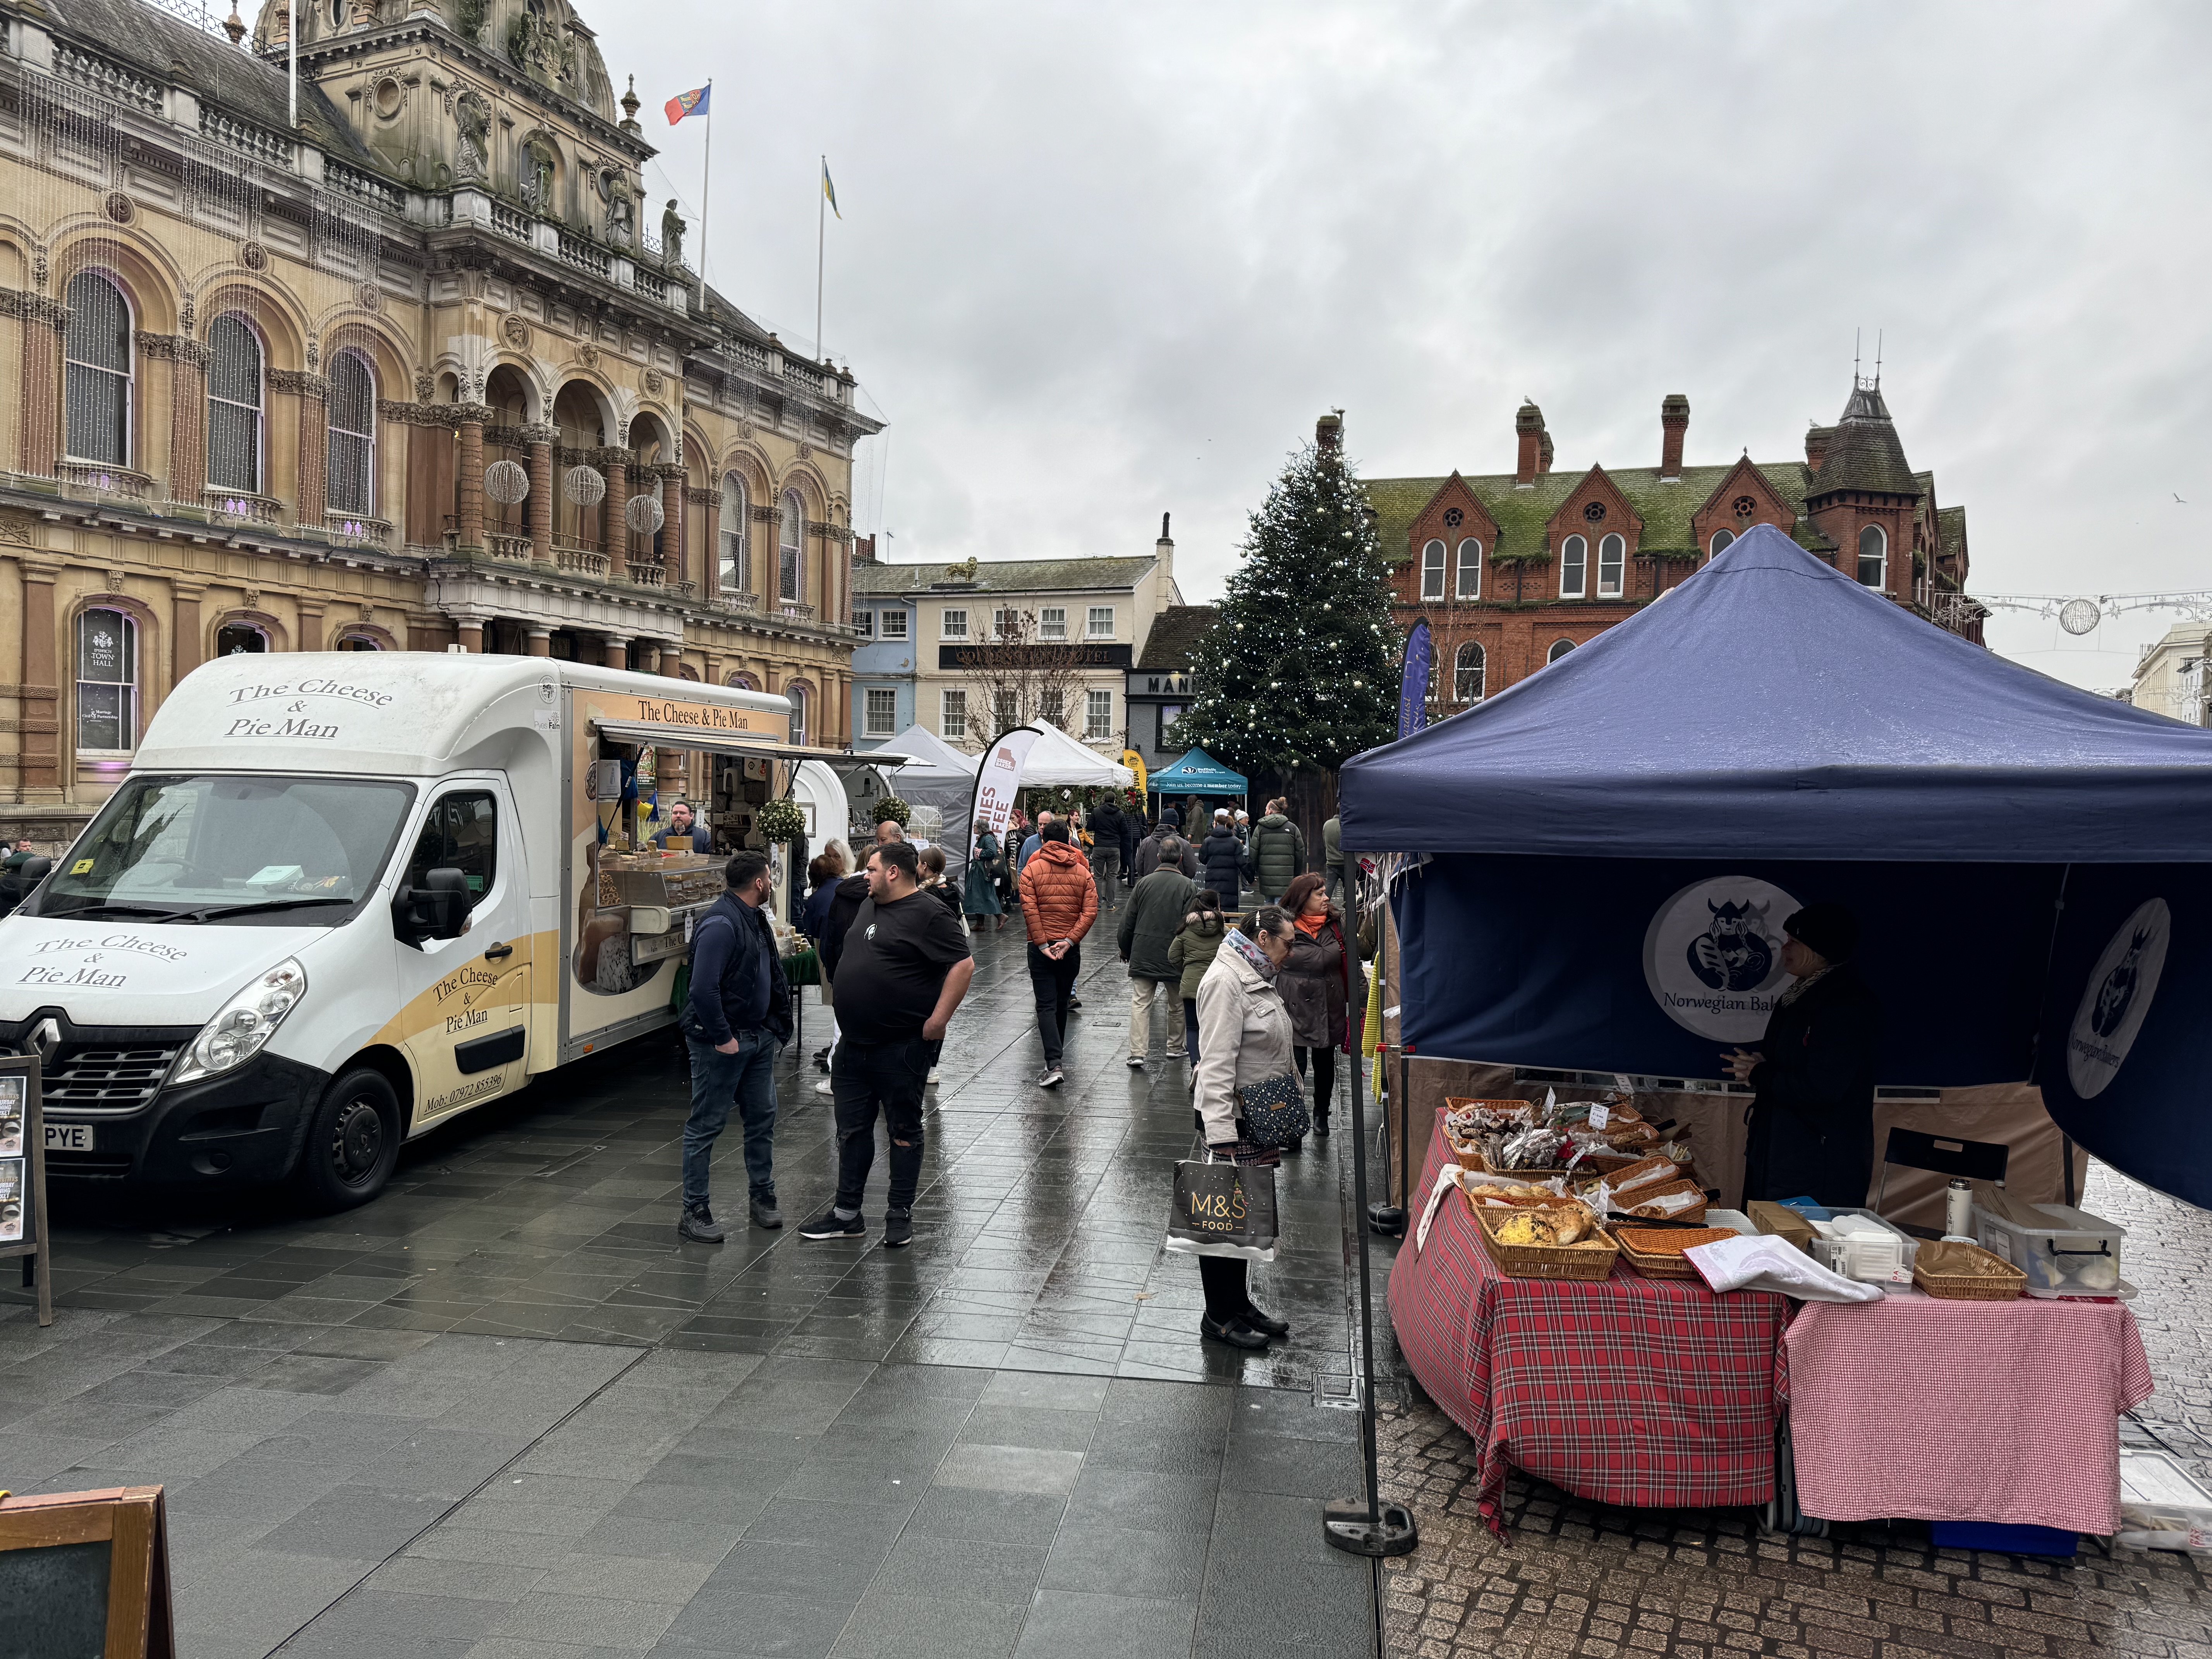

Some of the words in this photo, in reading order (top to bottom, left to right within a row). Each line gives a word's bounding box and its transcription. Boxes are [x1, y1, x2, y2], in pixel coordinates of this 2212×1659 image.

[1061, 651, 1112, 662] HOTEL
[229, 684, 289, 703] The
[298, 679, 393, 706] Cheese
[287, 700, 308, 713] &
[638, 699, 660, 721] The
[663, 703, 699, 725] Cheese
[702, 708, 710, 726] &
[713, 709, 726, 727] Pie
[729, 711, 748, 729] Man
[224, 718, 271, 736] Pie
[273, 719, 339, 738] Man
[995, 762, 1015, 771] BAKERY
[996, 757, 1012, 766] ESSEX
[36, 938, 93, 953] The
[100, 935, 187, 960] Cheese
[663, 935, 676, 948] The
[83, 952, 104, 963] &
[17, 967, 64, 982] Pie
[63, 968, 127, 987] Man
[433, 978, 457, 1002] The
[460, 967, 498, 985] Cheese
[463, 992, 471, 1005] &
[1664, 992, 1744, 1014] Norwegian
[446, 1014, 463, 1033] Pie
[465, 1009, 488, 1027] Man
[424, 1094, 447, 1113] Mob:
[450, 1084, 474, 1103] 07972
[475, 1072, 503, 1094] 855396
[45, 1127, 84, 1147] PYE
[1191, 1192, 1246, 1219] M&S
[1202, 1221, 1233, 1231] FOOD
